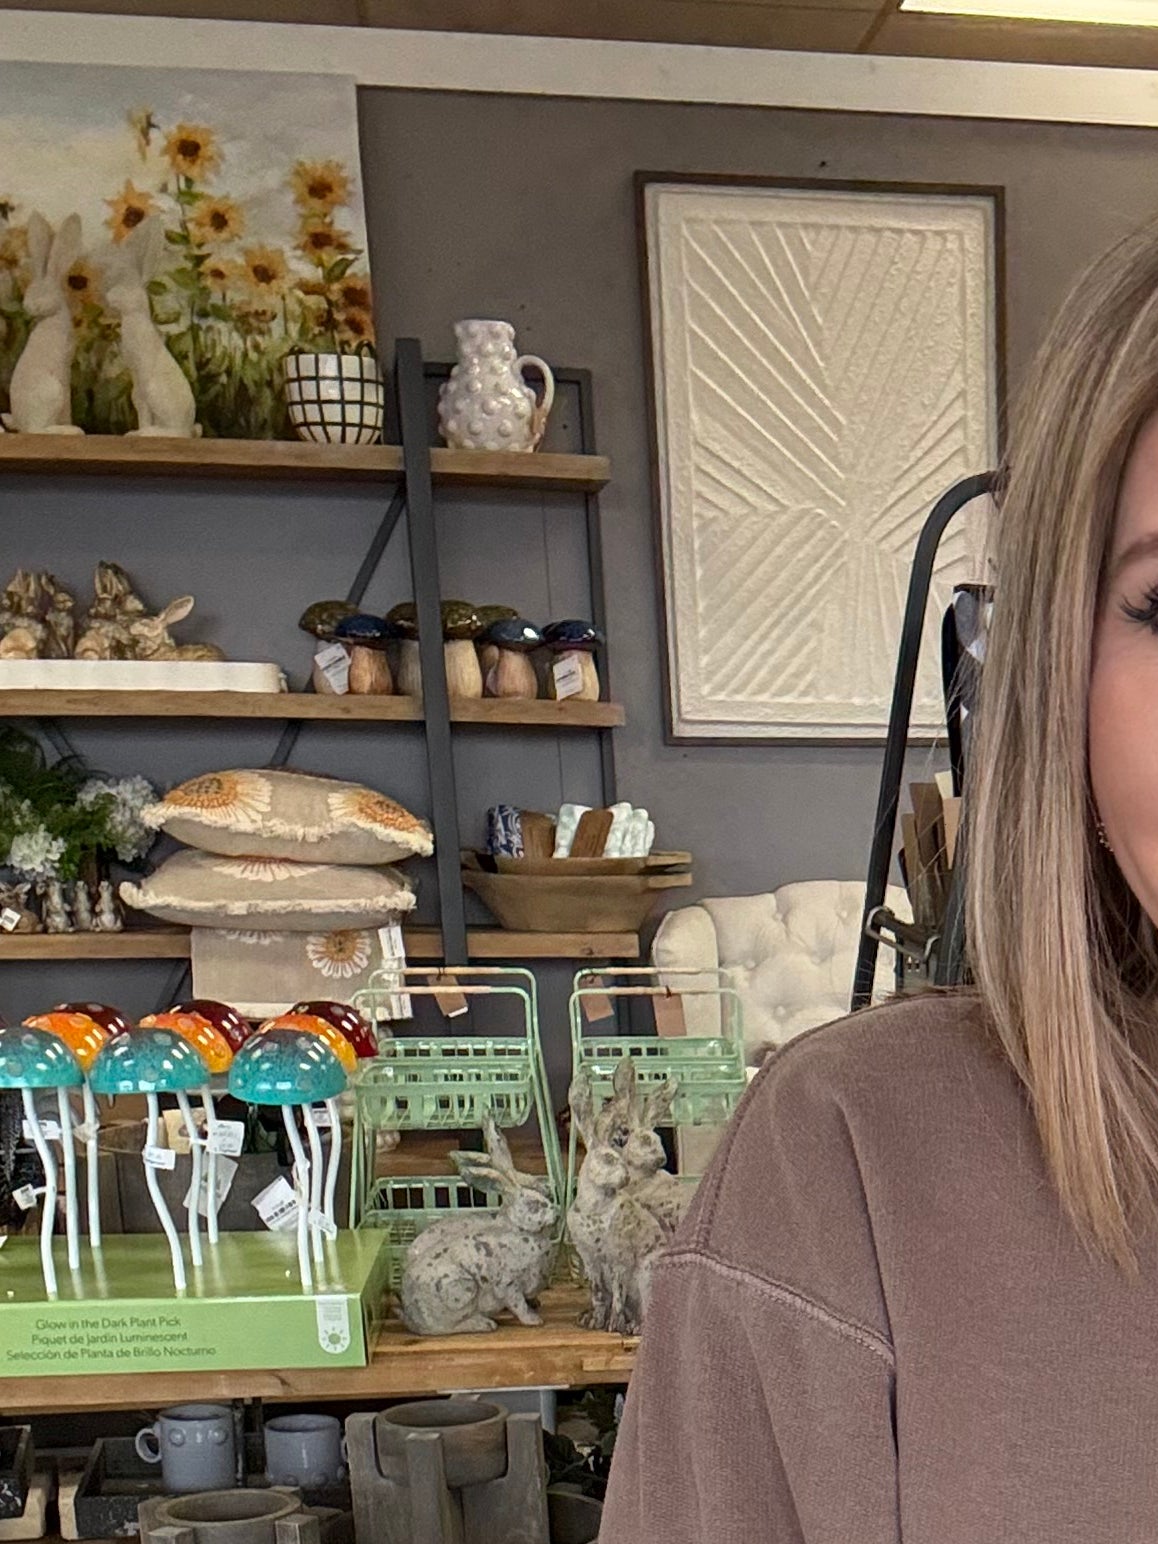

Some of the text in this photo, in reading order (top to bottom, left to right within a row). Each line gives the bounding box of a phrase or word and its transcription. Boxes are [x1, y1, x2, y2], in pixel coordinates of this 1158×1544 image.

[36, 1316, 181, 1330] Glow in the Dark Plant Pick
[31, 1334, 67, 1347] Piquet
[69, 1334, 84, 1344] de
[120, 1331, 188, 1343] Luminescent
[63, 1349, 79, 1359] de
[81, 1348, 114, 1359] Planta
[116, 1348, 131, 1358] de
[133, 1346, 161, 1357] Brillo
[164, 1345, 216, 1356] Nocturno
